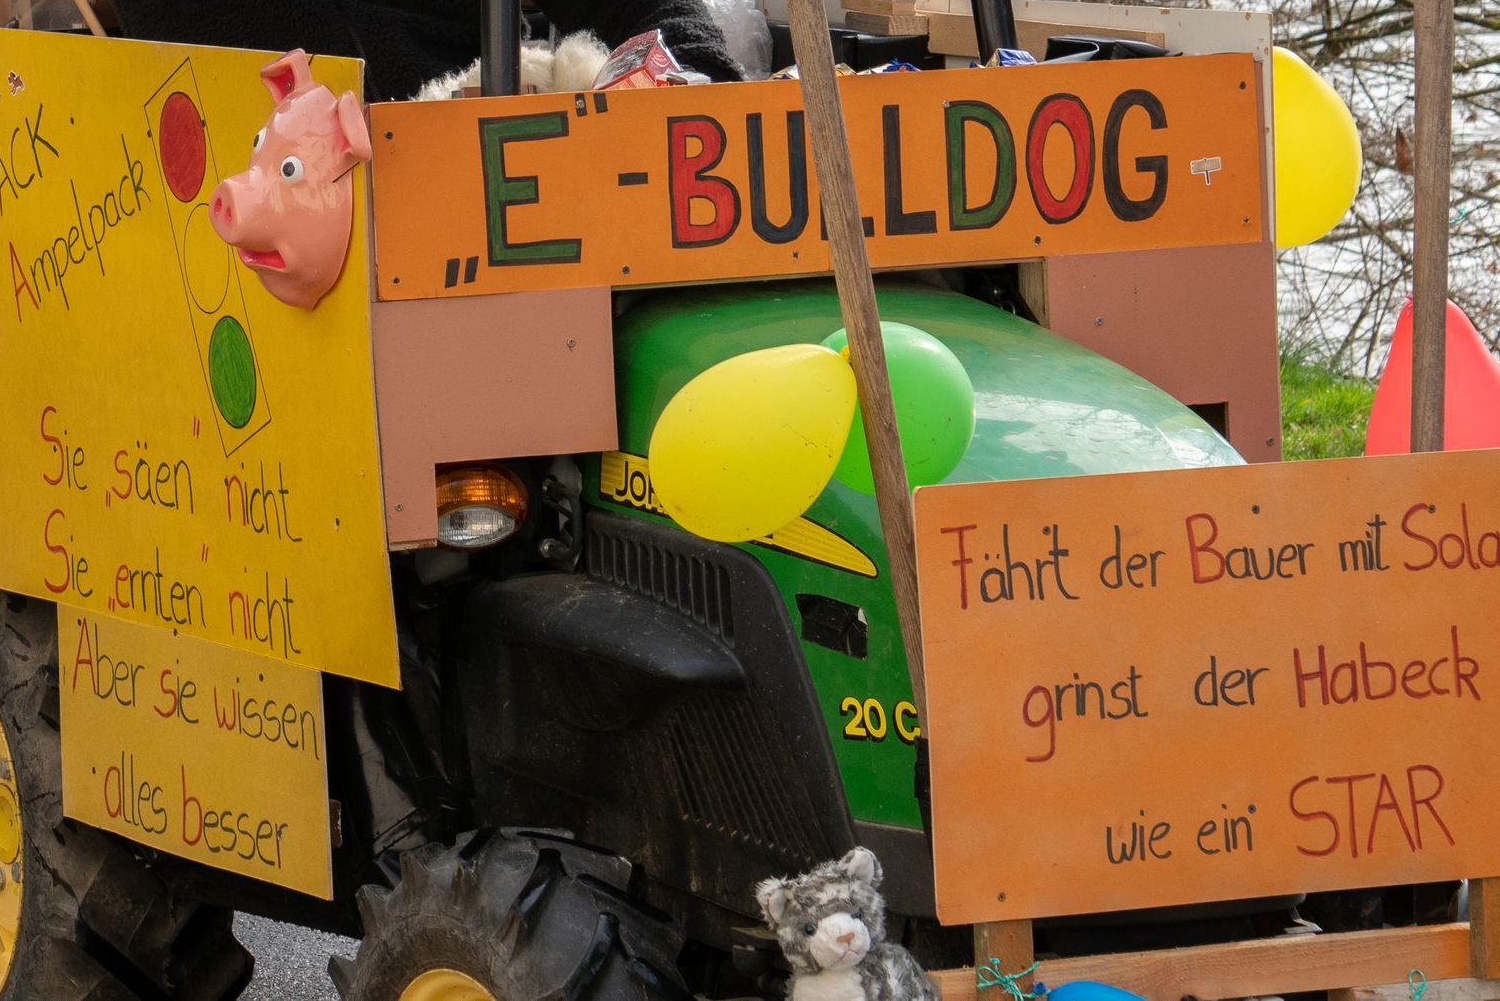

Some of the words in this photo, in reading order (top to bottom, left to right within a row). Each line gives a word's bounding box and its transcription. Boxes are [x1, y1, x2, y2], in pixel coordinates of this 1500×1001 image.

[8, 134, 151, 323] Ampelpack
[40, 405, 88, 492] Sie
[226, 461, 303, 543] nicht
[43, 509, 93, 598] Sie
[228, 566, 301, 656] nicht
[940, 523, 1080, 611] Fährt
[1100, 524, 1166, 589] der
[1185, 512, 1315, 585] Bauer
[1338, 514, 1390, 573] mit
[72, 616, 145, 708] Aber
[153, 658, 199, 724] sie
[213, 676, 320, 760] wissen
[840, 696, 887, 742] 20
[1022, 665, 1148, 762] grinst
[1194, 655, 1270, 708] der
[1293, 625, 1481, 708] Habeck
[103, 751, 168, 835] alles
[181, 764, 289, 869] besser
[1105, 808, 1172, 864] wie
[1196, 804, 1253, 855] ein
[1288, 764, 1455, 859] STAR
